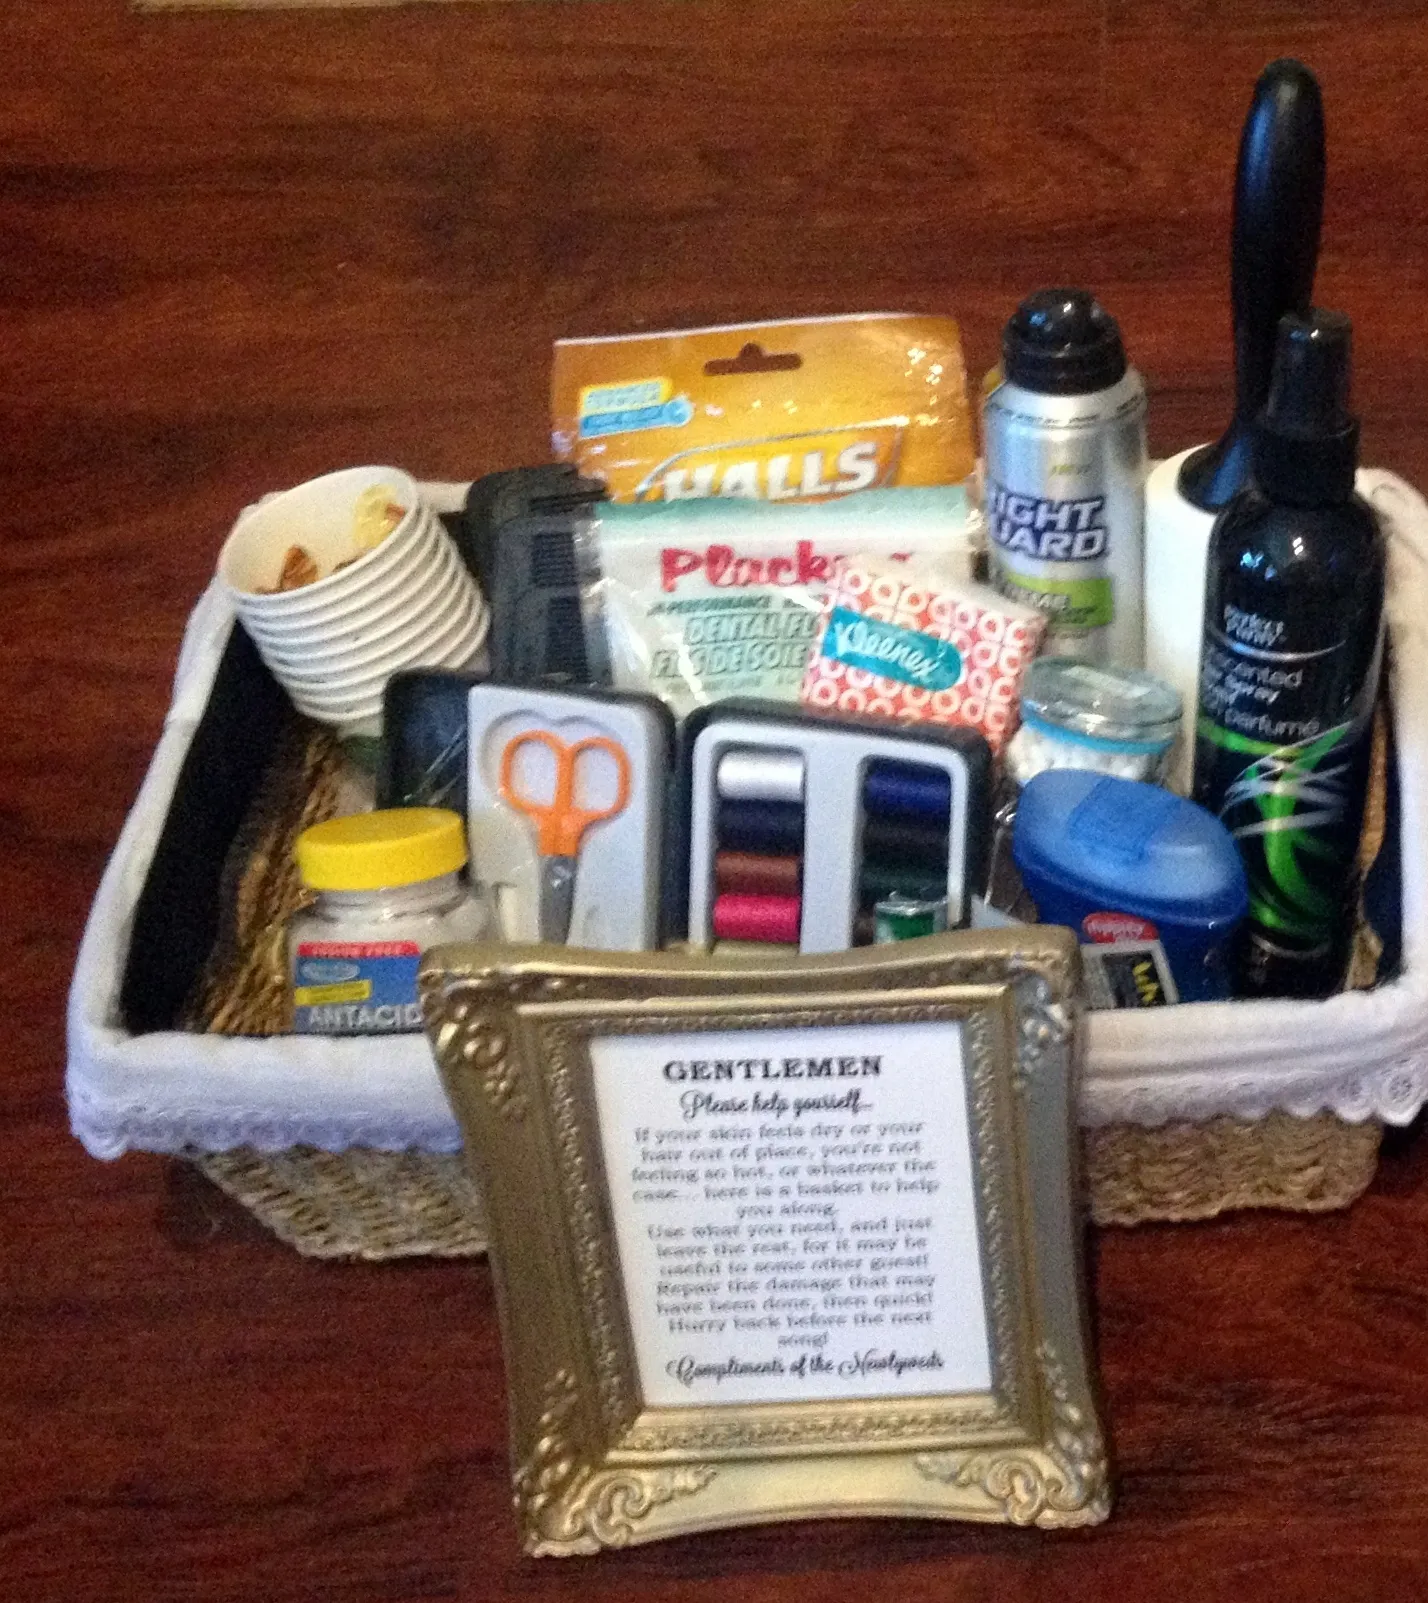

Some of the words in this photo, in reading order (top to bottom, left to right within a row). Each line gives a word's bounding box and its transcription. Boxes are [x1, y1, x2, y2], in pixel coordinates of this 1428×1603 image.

[662, 1055, 881, 1082] GENTLEMEN
[679, 1090, 748, 1122] Please
[751, 1090, 789, 1119] help
[665, 1355, 785, 1386] Compliments
[789, 1353, 806, 1378] of
[809, 1352, 834, 1374] the
[837, 1348, 944, 1378] Newlyweds
